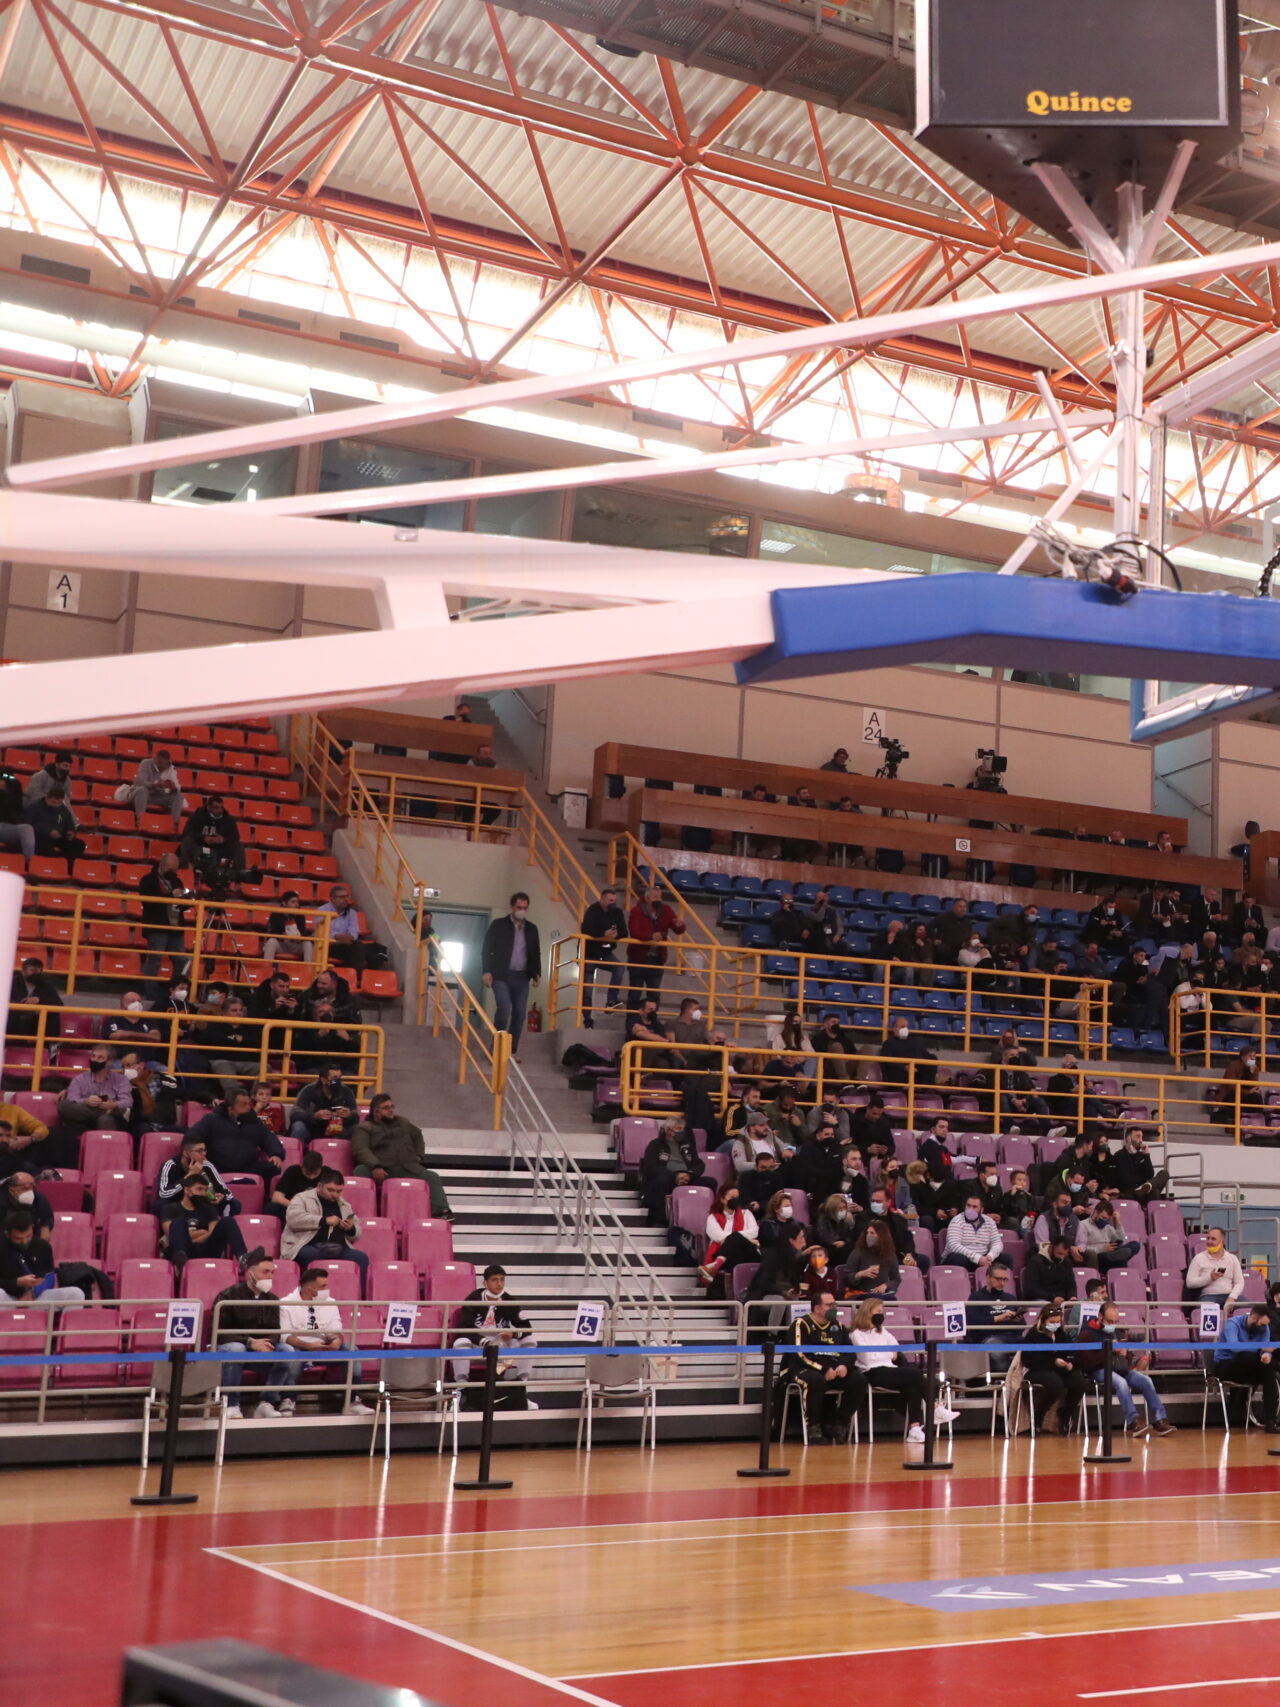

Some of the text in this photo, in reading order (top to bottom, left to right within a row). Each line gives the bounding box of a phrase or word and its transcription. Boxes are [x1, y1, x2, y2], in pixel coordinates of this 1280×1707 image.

[1026, 90, 1132, 116] Quince
[56, 574, 72, 591] A
[60, 593, 68, 609] 1
[868, 711, 880, 726] A
[864, 727, 882, 741] 24
